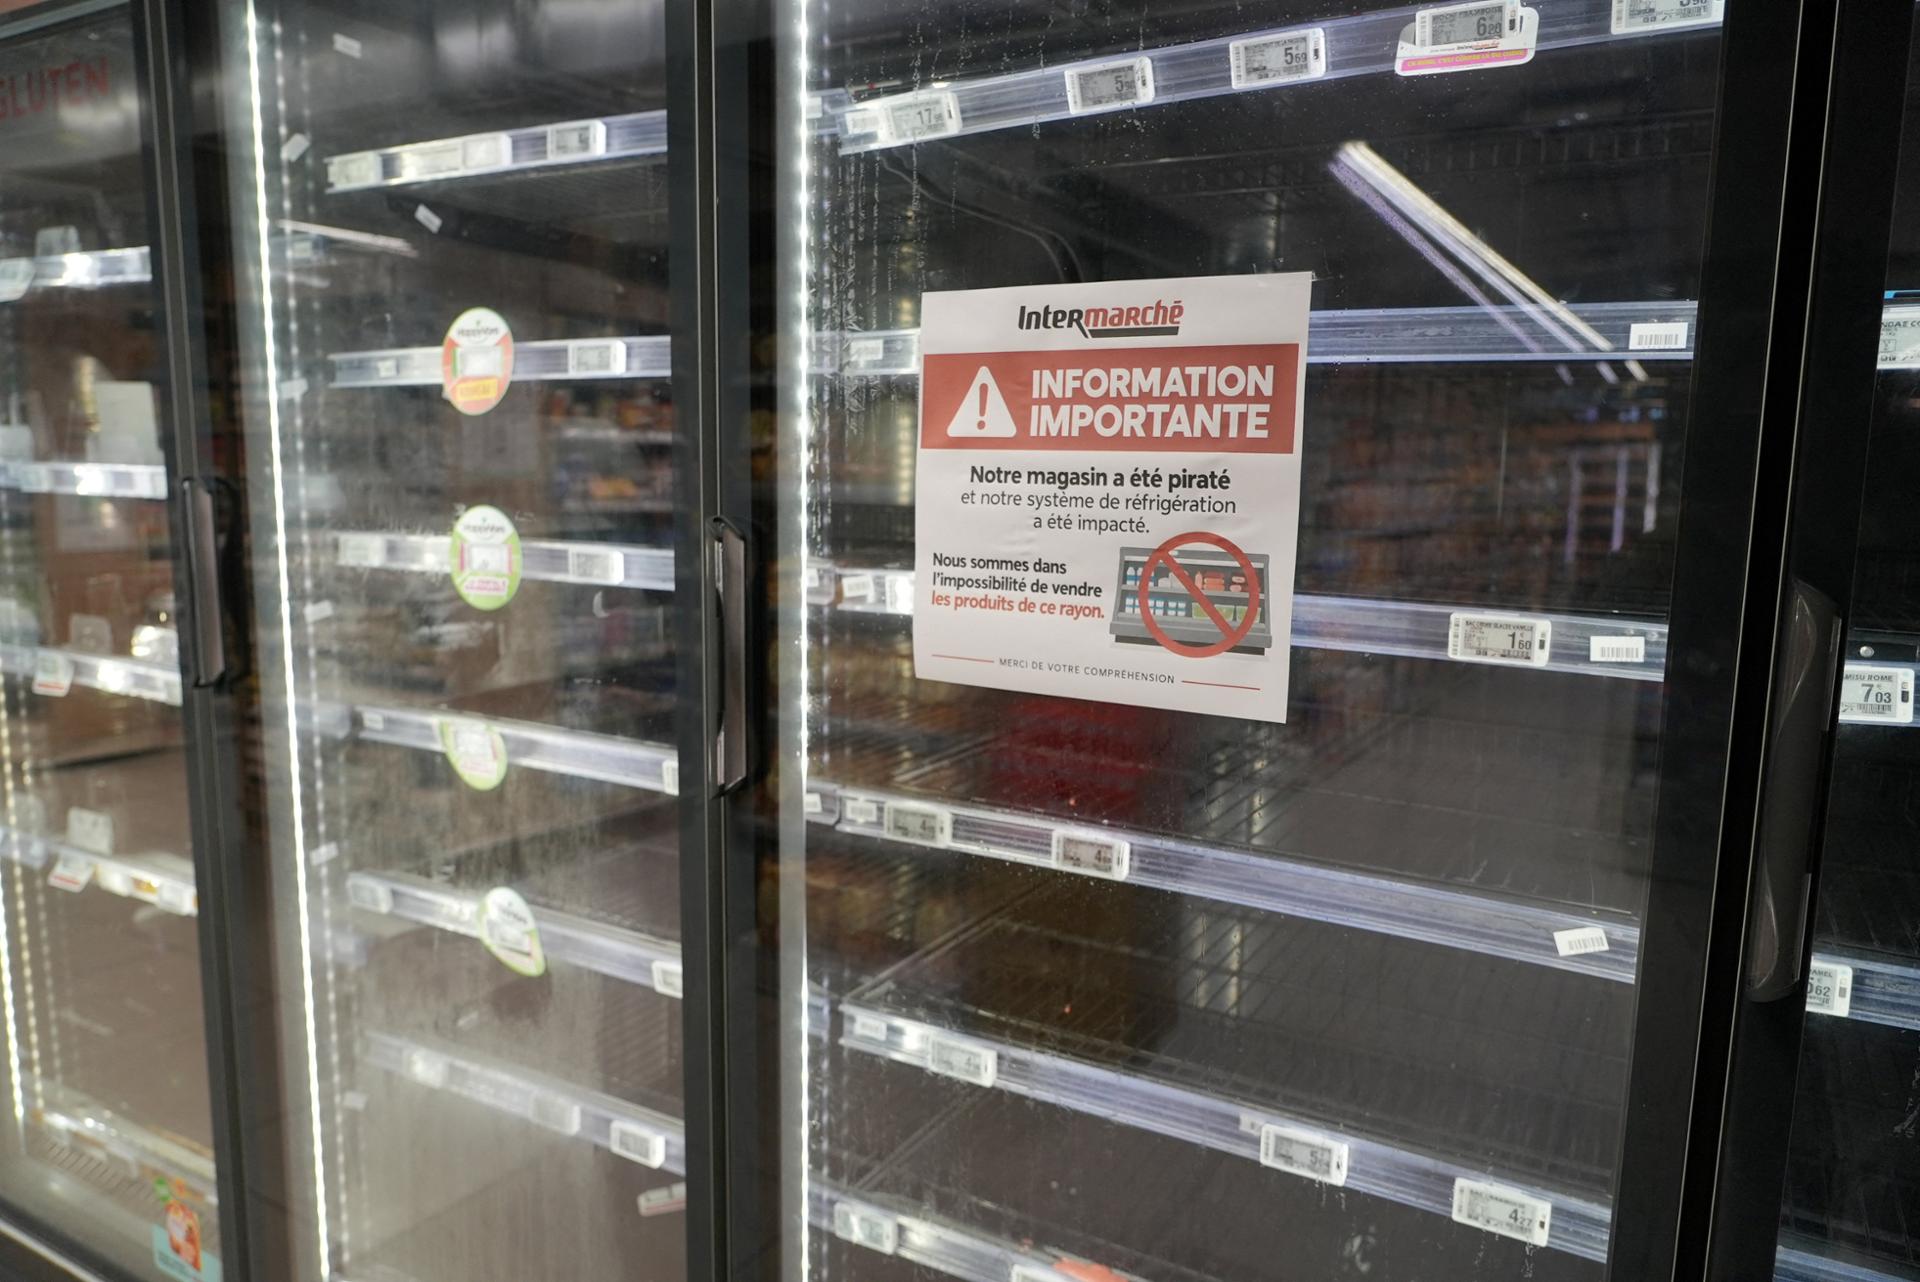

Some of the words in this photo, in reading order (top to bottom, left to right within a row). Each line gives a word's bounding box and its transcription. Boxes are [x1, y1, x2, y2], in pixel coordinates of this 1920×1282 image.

[1018, 299, 1184, 339] Intermarché
[1032, 365, 1275, 399] INFORMATION
[1030, 404, 1271, 439] IMPORTANTE
[970, 465, 1022, 485] Notre
[1027, 467, 1108, 490] magasin
[1113, 473, 1125, 487] a
[1130, 467, 1163, 488] été
[1168, 468, 1232, 493] piraté
[960, 491, 976, 505] et
[981, 492, 1022, 506] notre
[1026, 491, 1094, 511] système
[1099, 493, 1120, 510] de
[1125, 494, 1237, 515] réfrigération
[1033, 517, 1043, 529] a
[1047, 513, 1073, 530] été
[1077, 514, 1150, 535] impacté.
[932, 552, 967, 568] Nous
[970, 557, 1030, 572] sommes
[1033, 558, 1067, 574] dans
[1030, 579, 1048, 594] de
[1052, 581, 1103, 598] vendre
[931, 590, 951, 606] les
[954, 594, 1015, 611] produits
[1018, 597, 1036, 613] de
[1039, 601, 1056, 615] ce
[1059, 604, 1105, 620] rayon.
[999, 657, 1029, 669] MERCI
[1032, 660, 1043, 670] DE
[1048, 663, 1080, 674] VOTRE
[1084, 666, 1175, 684] COMPRÉHENSION
[1867, 674, 1893, 682] ROME
[1810, 969, 1832, 978] AMEL
